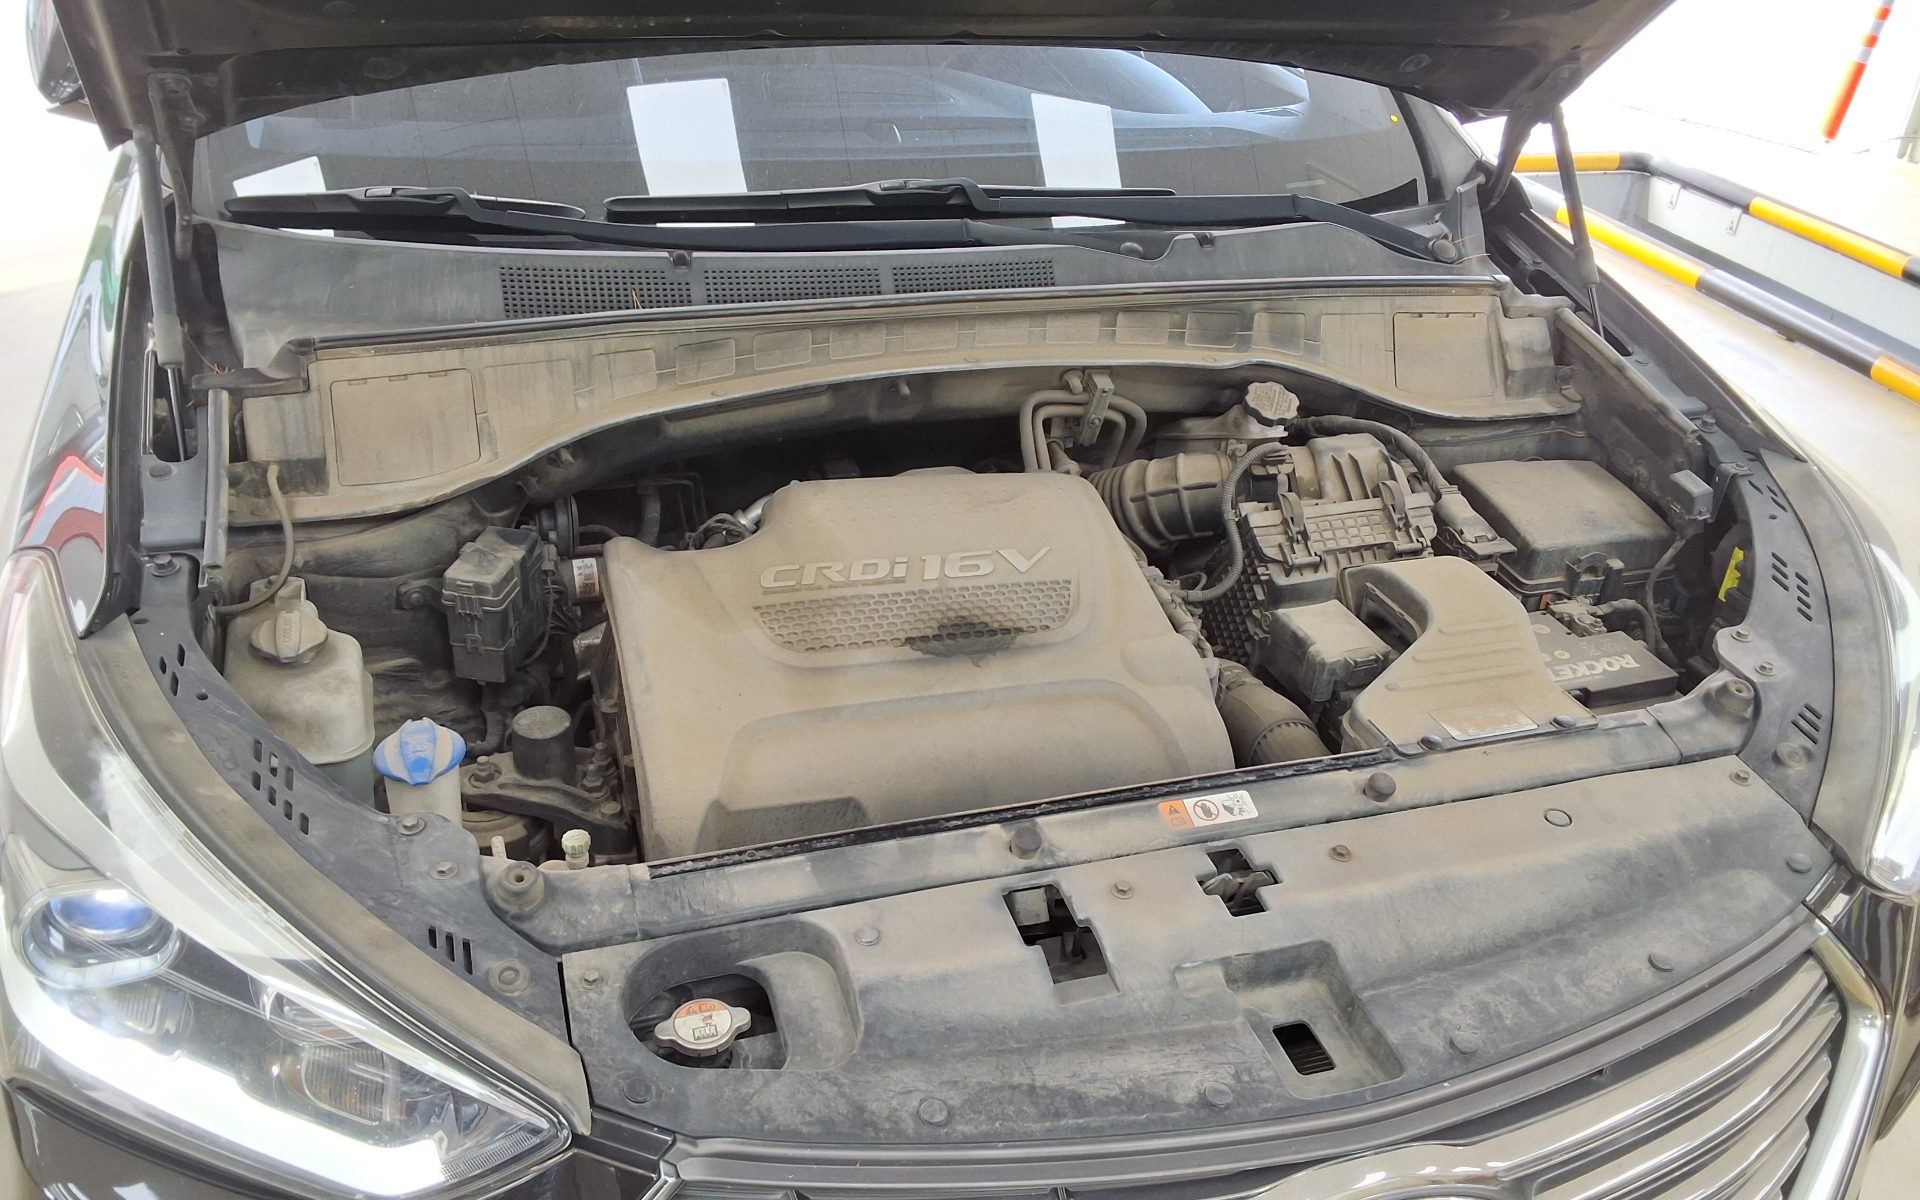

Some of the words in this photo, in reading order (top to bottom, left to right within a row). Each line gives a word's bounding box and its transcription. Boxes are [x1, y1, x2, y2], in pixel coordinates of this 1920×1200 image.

[760, 556, 909, 588] CRDi
[920, 546, 1051, 580] 16V
[1549, 653, 1640, 681] ROCKE
